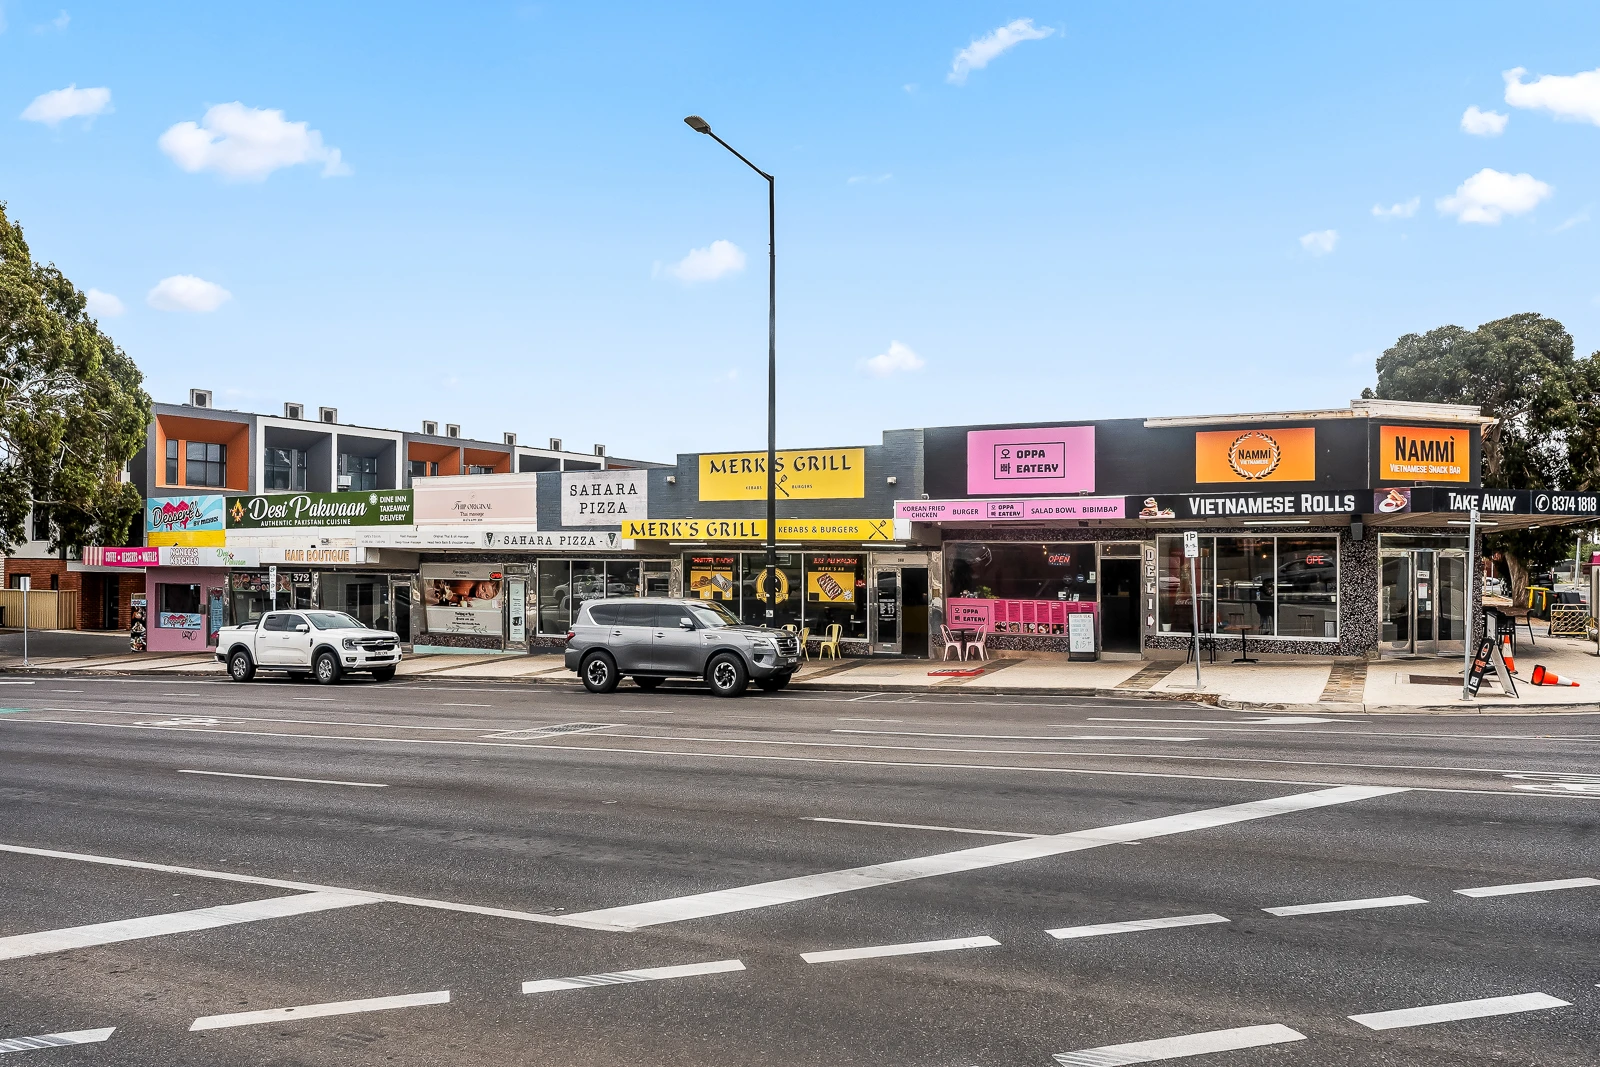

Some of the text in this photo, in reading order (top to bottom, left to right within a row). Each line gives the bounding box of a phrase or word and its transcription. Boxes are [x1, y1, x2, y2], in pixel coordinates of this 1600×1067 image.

[1000, 449, 1010, 459] 오
[1016, 450, 1045, 459] OPPA
[710, 454, 852, 474] MERKS GRILL
[1000, 462, 1011, 474] 빠
[1016, 464, 1058, 474] EATERY
[1390, 464, 1461, 474] VIETNAMESE SNACK BAR
[570, 483, 638, 496] SAHARA
[248, 496, 367, 520] Desi Pakwaan
[580, 502, 628, 514] PIZZA
[1189, 494, 1355, 515] VIETNAMESE ROLLS
[1448, 492, 1596, 512] TAKE AWAY 8374 1818
[152, 501, 203, 528] Dessert's
[630, 522, 760, 537] MERK'S GRILL
[503, 536, 596, 546] SAHARA PIZZA
[170, 556, 199, 565] KITCHEN
[285, 550, 350, 562] HAIR BOUTIQUE
[293, 573, 310, 582] 372
